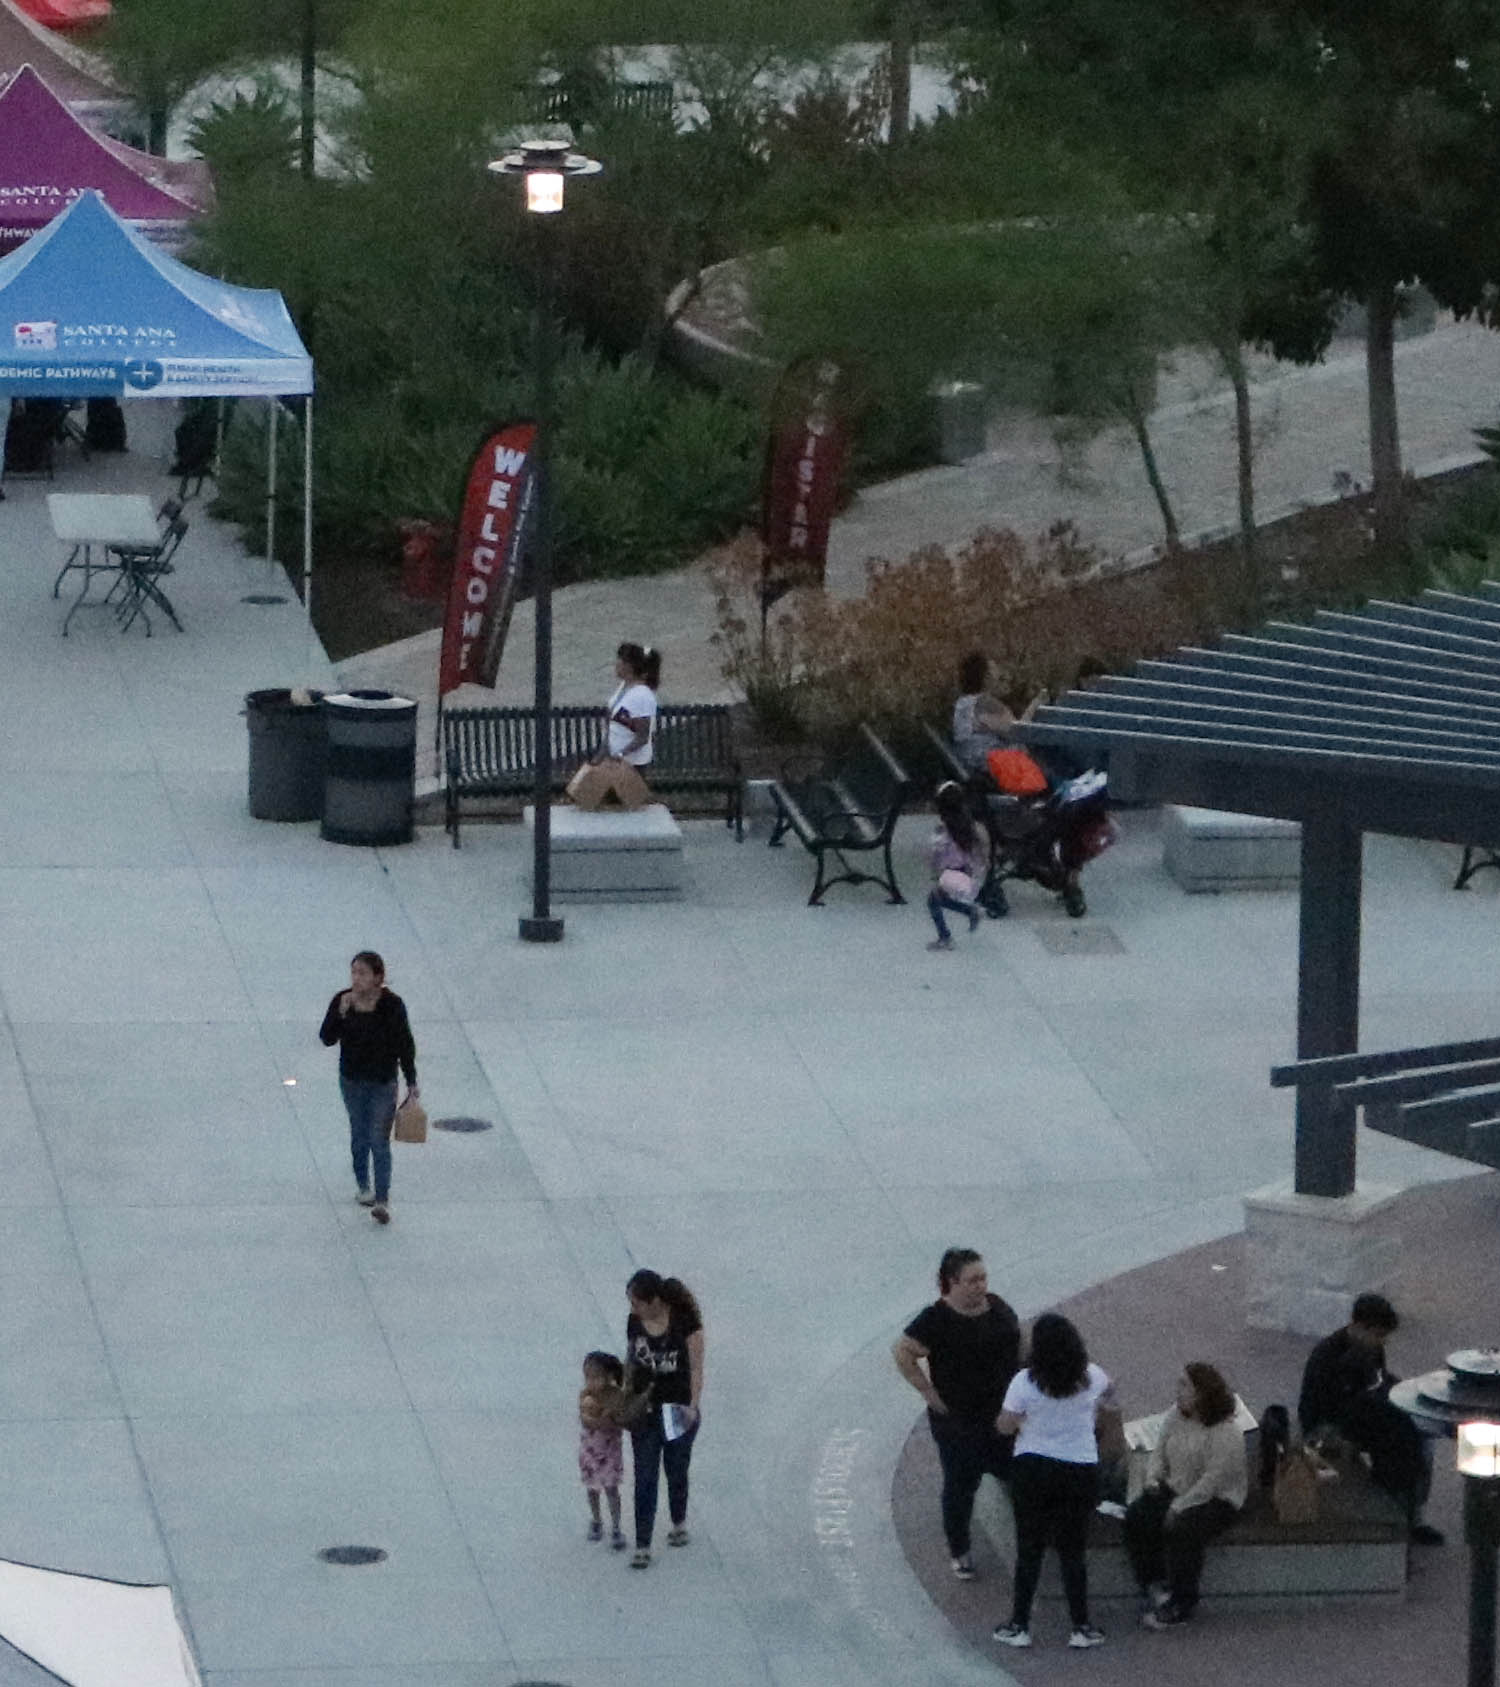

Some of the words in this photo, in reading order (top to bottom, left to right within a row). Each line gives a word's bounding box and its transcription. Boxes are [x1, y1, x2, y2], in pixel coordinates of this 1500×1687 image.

[0, 185, 62, 197] SANTA
[63, 324, 128, 337] SANTA
[134, 326, 177, 338] ANA
[45, 366, 117, 380] PATHWAYS
